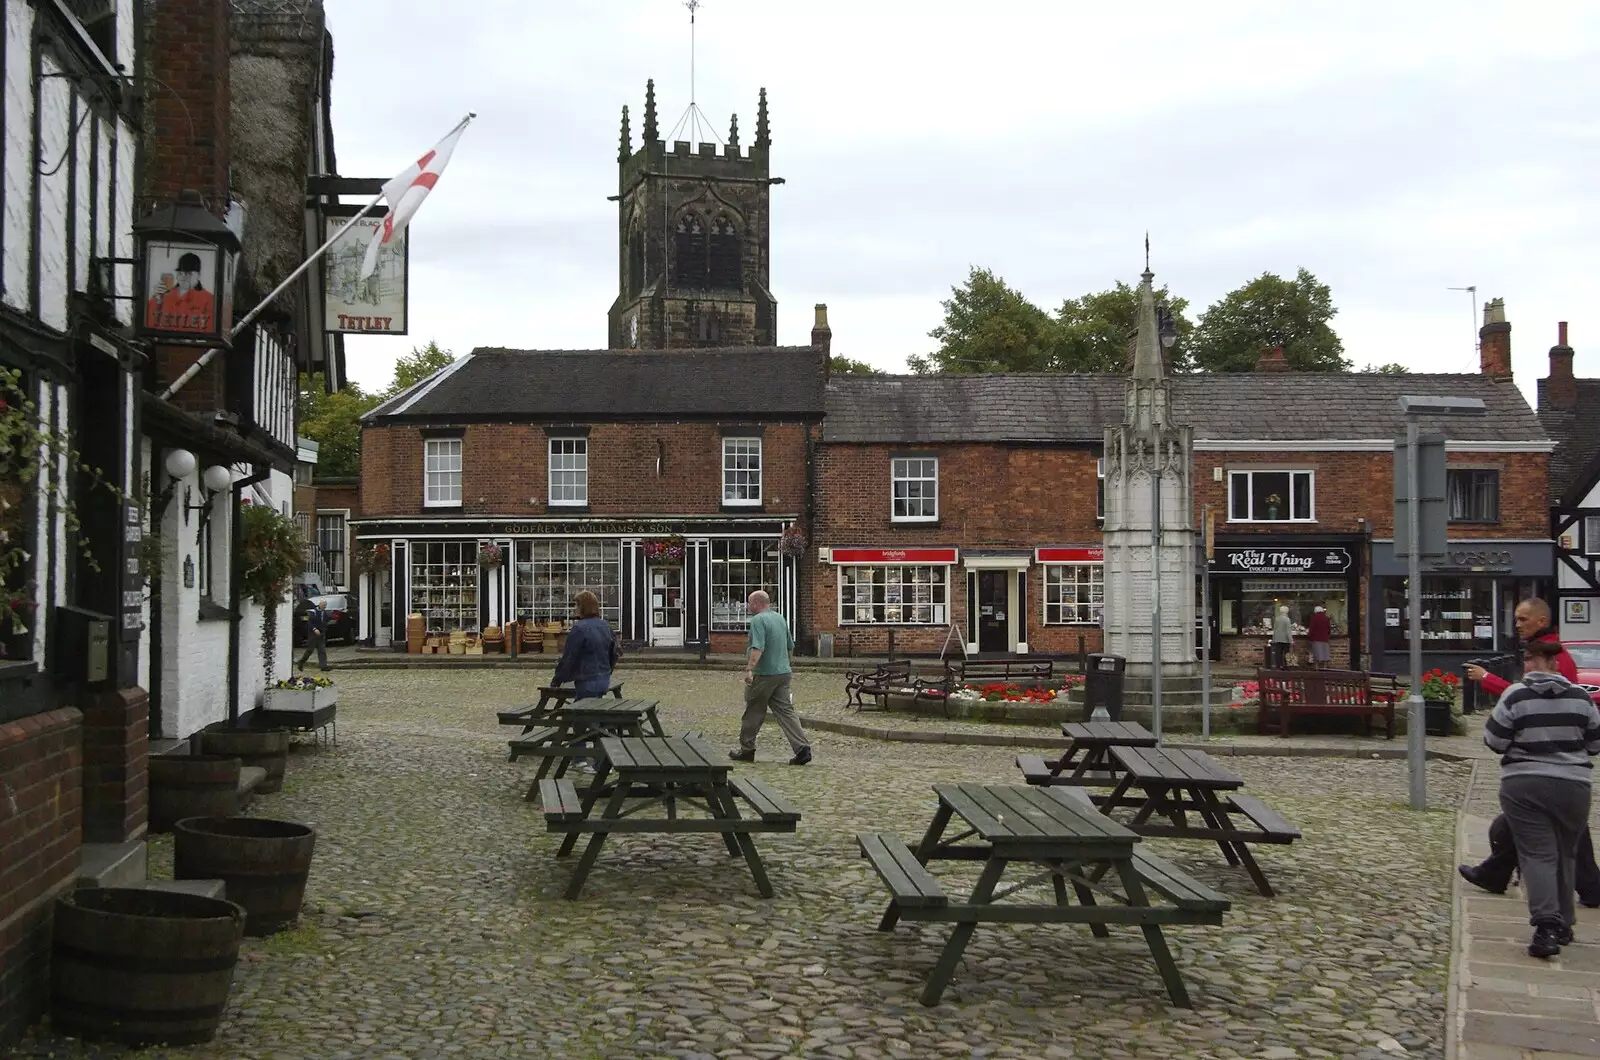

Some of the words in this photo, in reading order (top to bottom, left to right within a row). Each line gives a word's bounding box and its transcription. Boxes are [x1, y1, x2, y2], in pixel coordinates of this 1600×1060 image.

[360, 219, 381, 227] BLAC
[153, 312, 209, 329] TETLEY
[337, 314, 392, 330] TETLEY
[504, 525, 559, 533] GODFREY
[564, 525, 576, 533] C.
[578, 525, 634, 533] WILLIAMS
[637, 525, 645, 533] &
[649, 525, 673, 533] SON
[1243, 549, 1261, 558] The
[1227, 552, 1266, 569] Real
[1267, 552, 1314, 569] Thing
